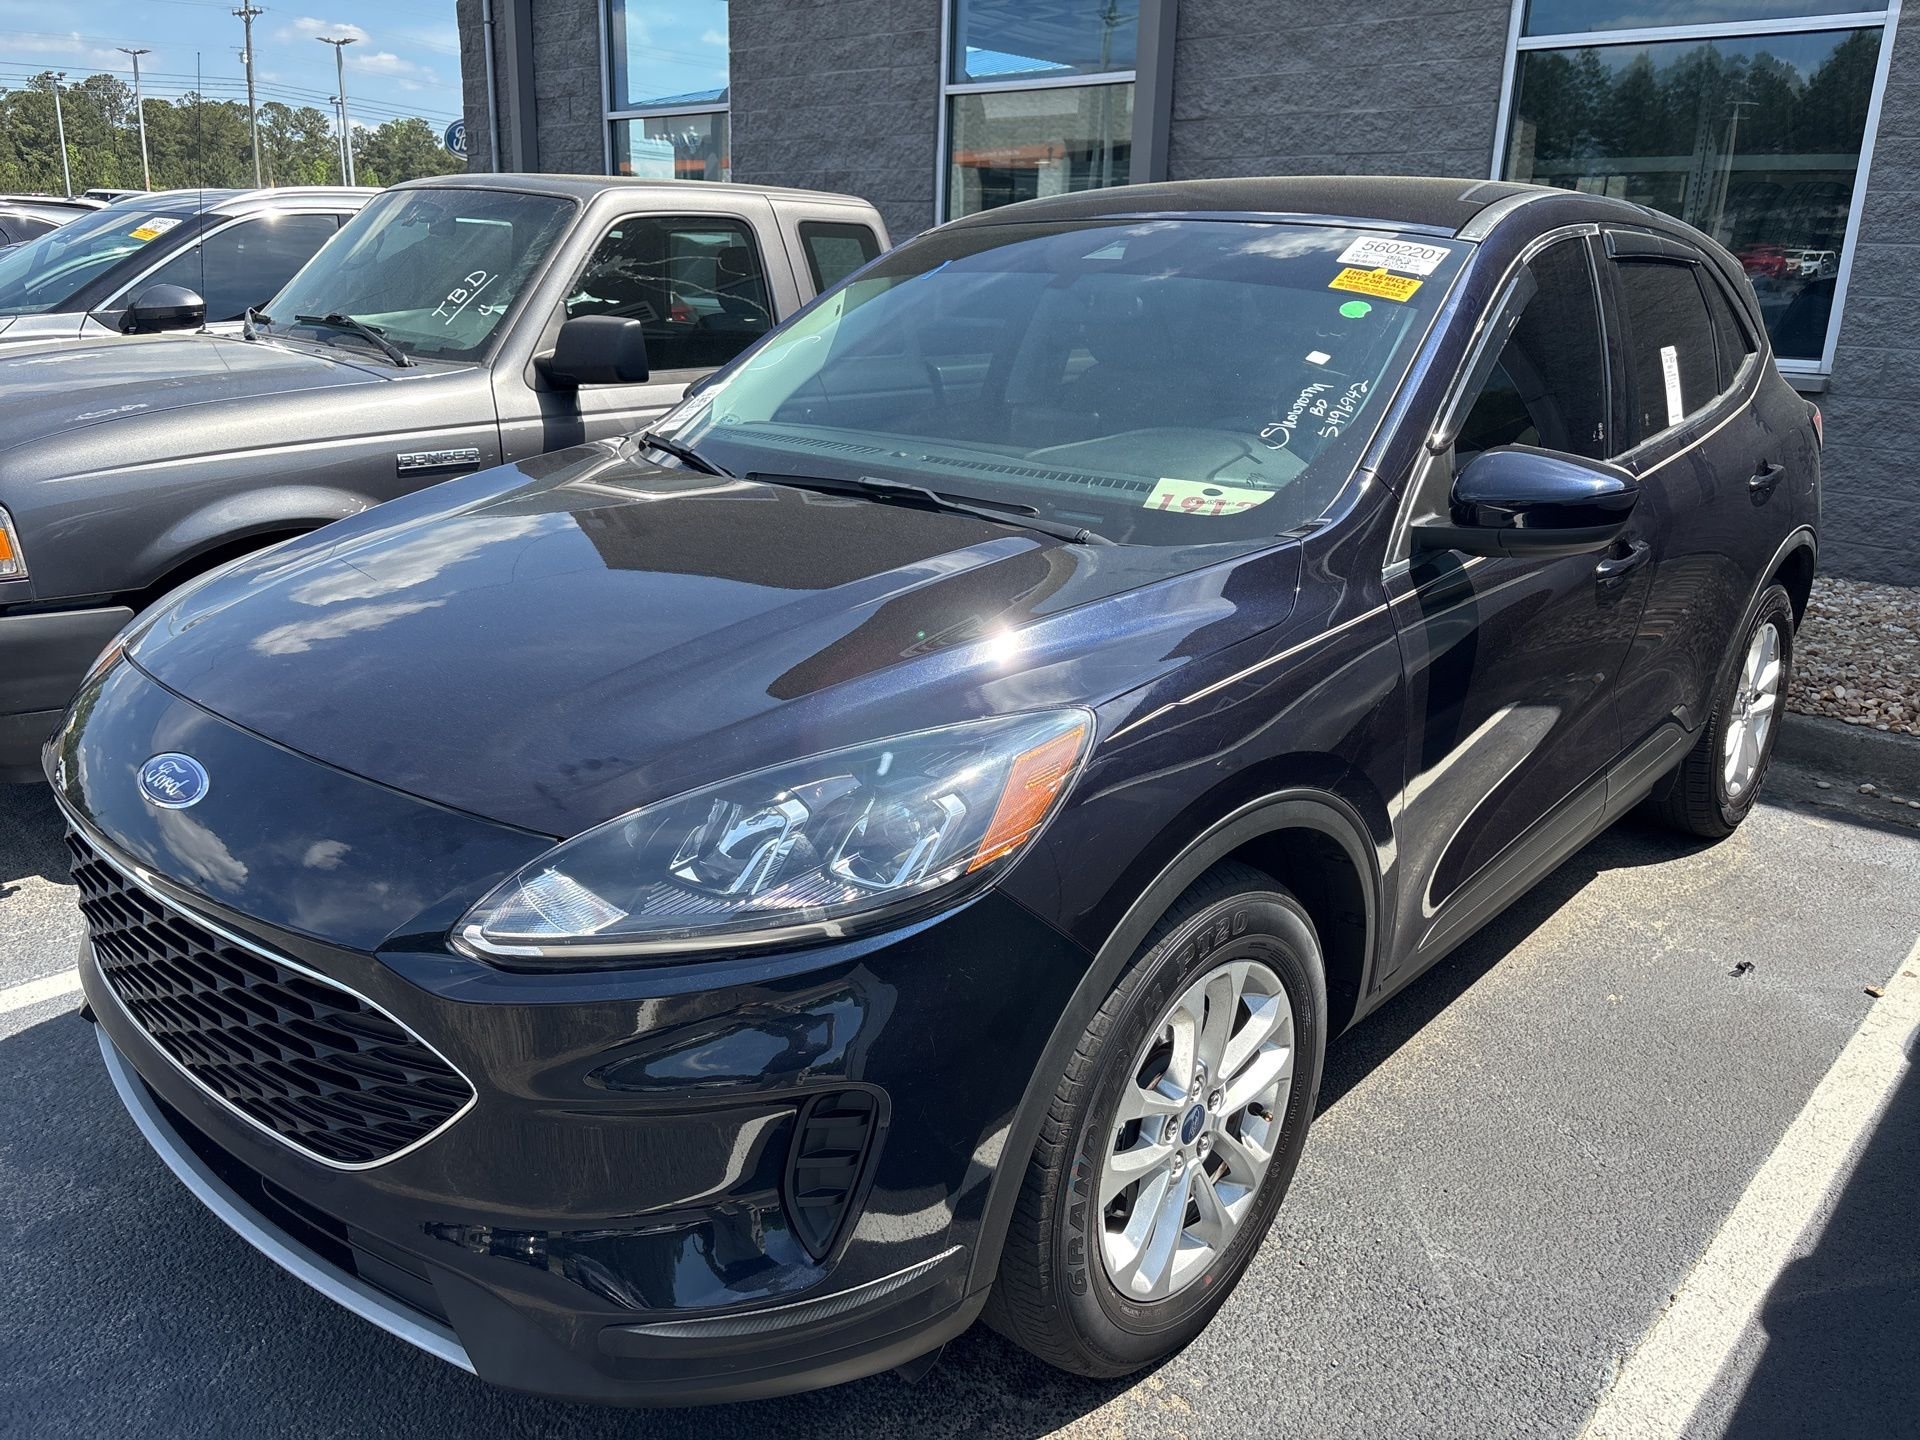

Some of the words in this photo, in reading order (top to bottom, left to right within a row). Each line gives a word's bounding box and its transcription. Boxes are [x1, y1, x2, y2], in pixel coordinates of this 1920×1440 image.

[1361, 240, 1447, 261] 5602201
[1347, 269, 1369, 278] THIS
[1372, 273, 1416, 286] VEHICLE
[1384, 281, 1409, 290] SALE
[1317, 380, 1369, 438] 5496942
[399, 449, 480, 467] RANGER
[145, 760, 190, 796] Ford
[1175, 909, 1249, 979] PT20
